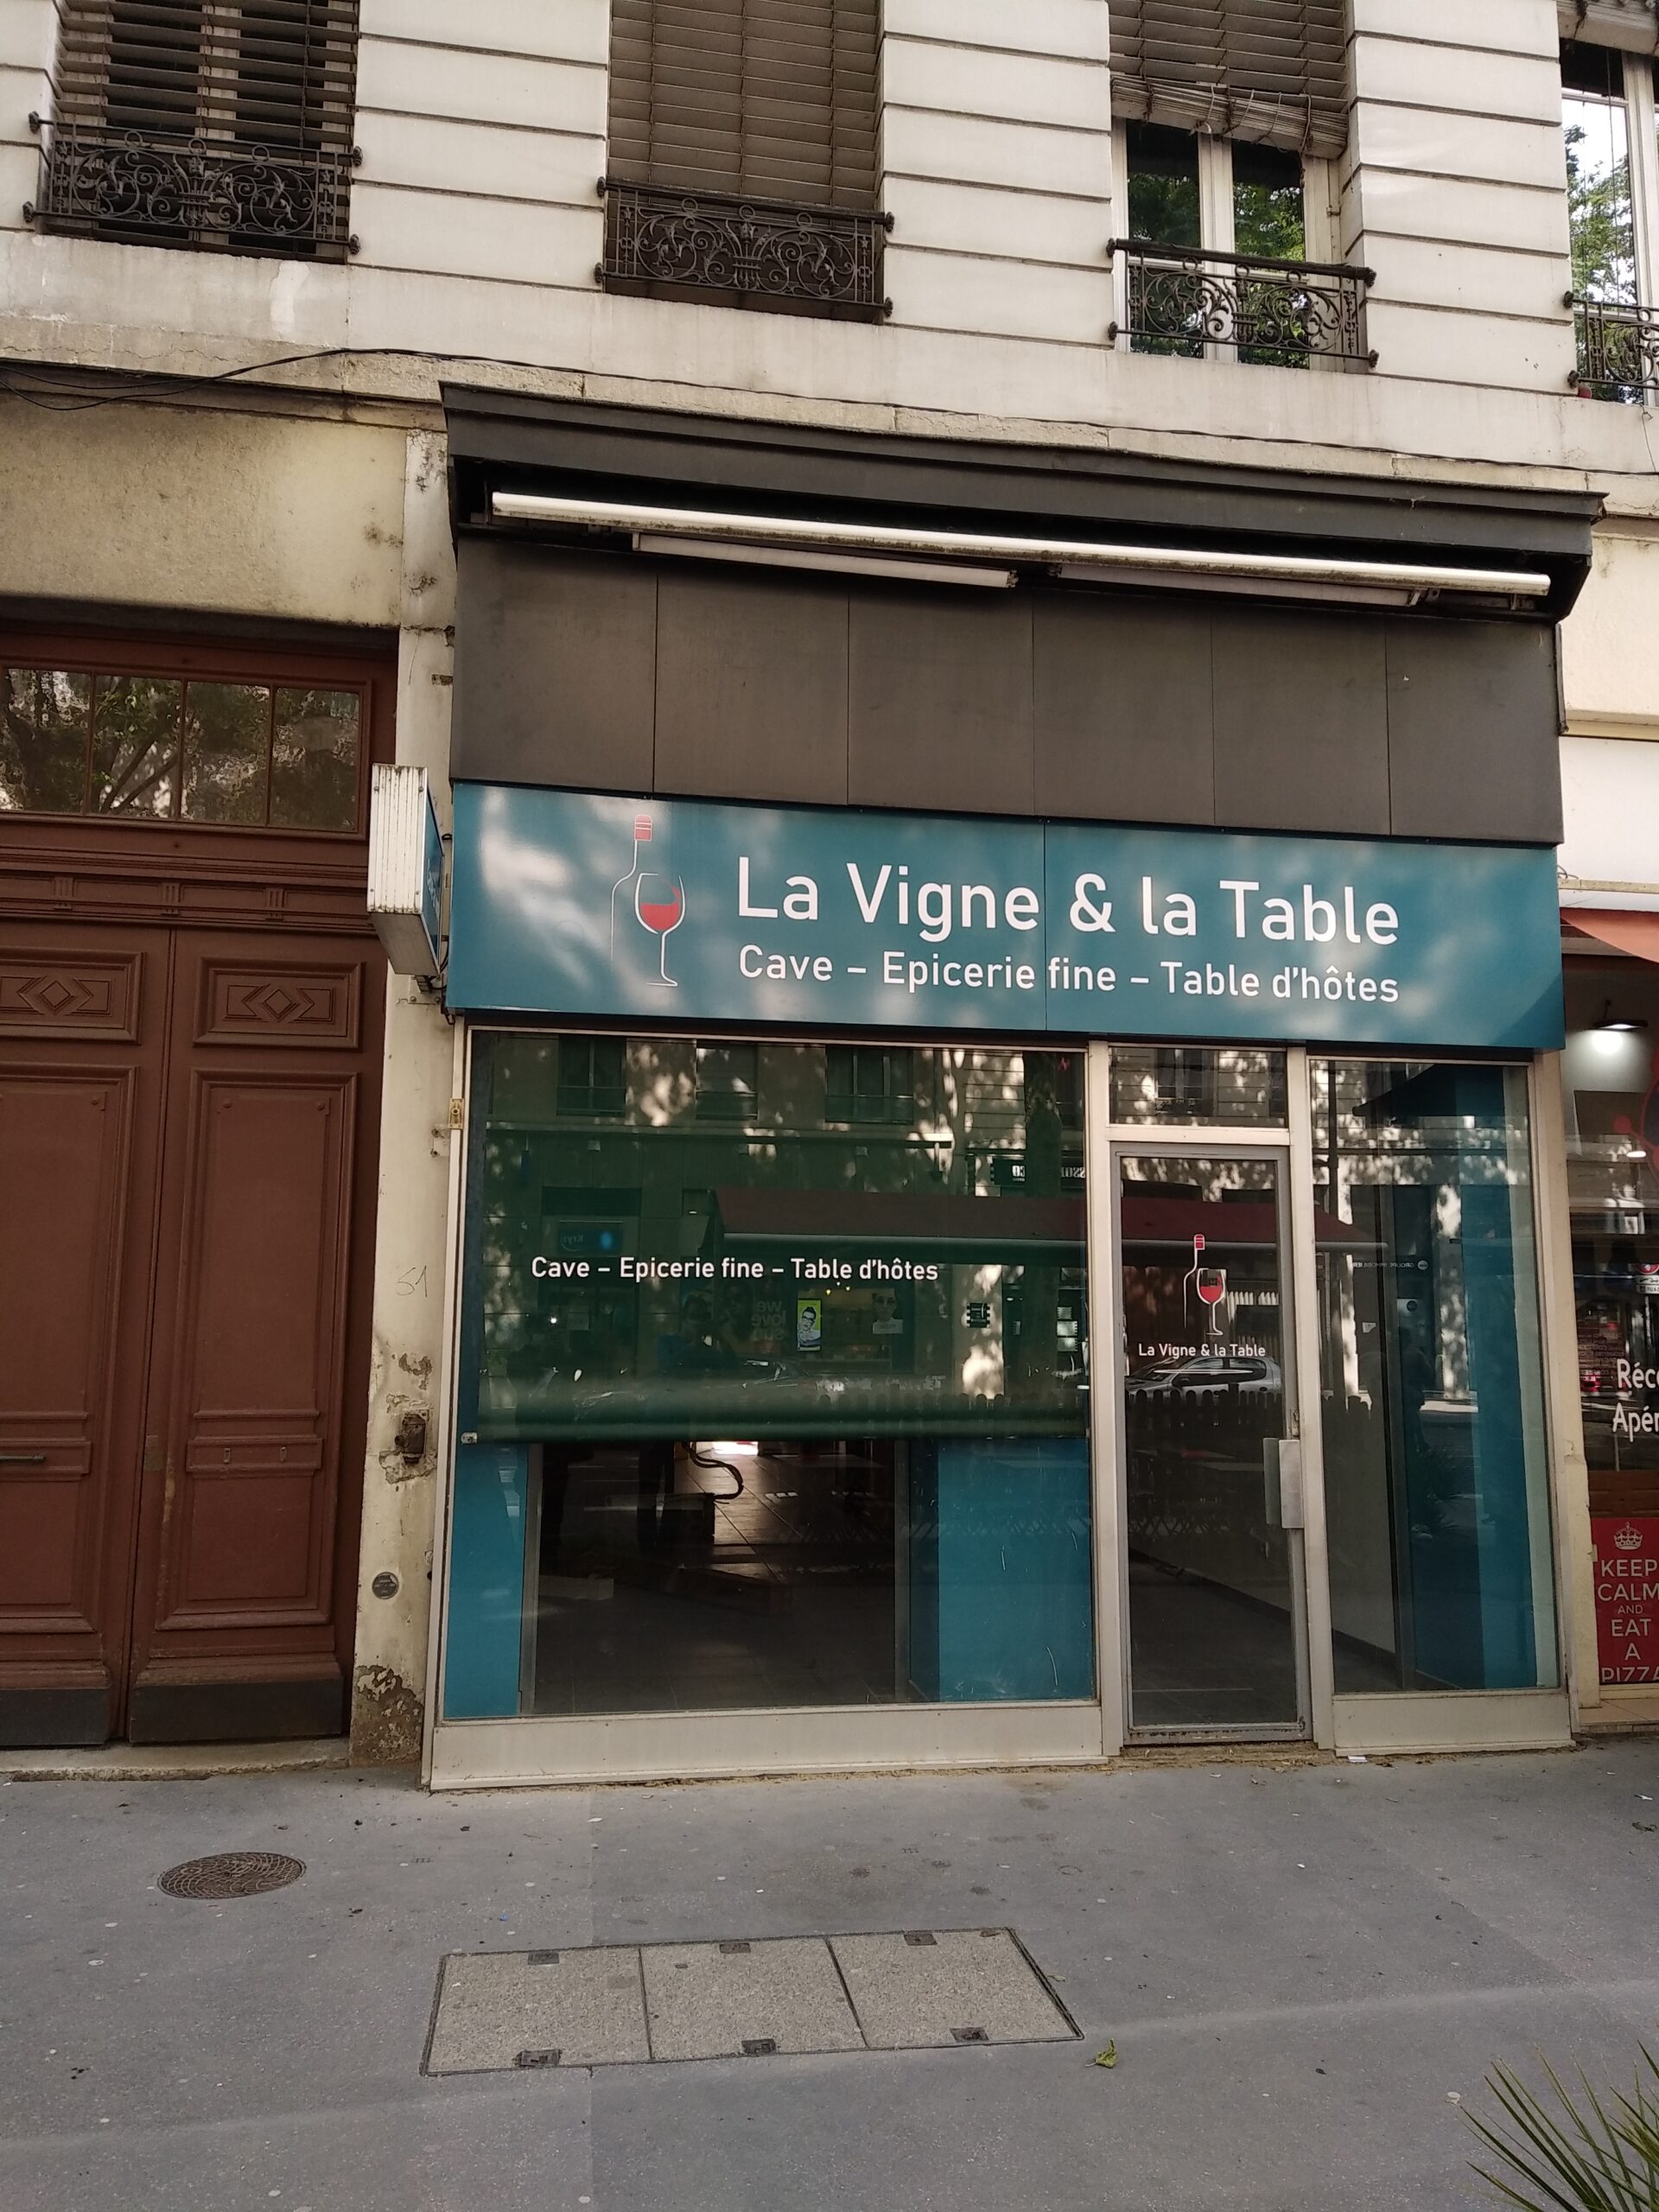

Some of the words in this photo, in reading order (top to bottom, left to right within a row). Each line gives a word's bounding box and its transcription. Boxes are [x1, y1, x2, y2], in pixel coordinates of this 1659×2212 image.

[738, 856, 818, 920] La
[846, 862, 1039, 942] Vigne
[1069, 873, 1116, 932] &
[1141, 876, 1197, 936] la
[1219, 880, 1399, 945] Table
[739, 944, 833, 982] Cave
[883, 951, 1035, 993] Epicerie
[1048, 957, 1116, 991] fine
[1160, 962, 1260, 997] Table
[1272, 965, 1399, 1002] d'hôtes
[531, 1256, 590, 1278] Cave
[620, 1256, 715, 1282] Epicerie
[721, 1257, 764, 1278] fine
[791, 1258, 852, 1279] Table
[859, 1257, 938, 1280] d'hôtes
[1139, 1344, 1155, 1356] La
[1159, 1344, 1196, 1359] Vigne
[1201, 1344, 1210, 1357] &
[1214, 1344, 1226, 1357] la
[1230, 1344, 1266, 1357] Table
[1617, 1358, 1659, 1389] Réc
[1601, 1559, 1657, 1578] KEEP
[1598, 1583, 1659, 1601] CALM
[1618, 1605, 1643, 1614] AND
[1611, 1618, 1651, 1637] EAT
[1624, 1643, 1641, 1661] A
